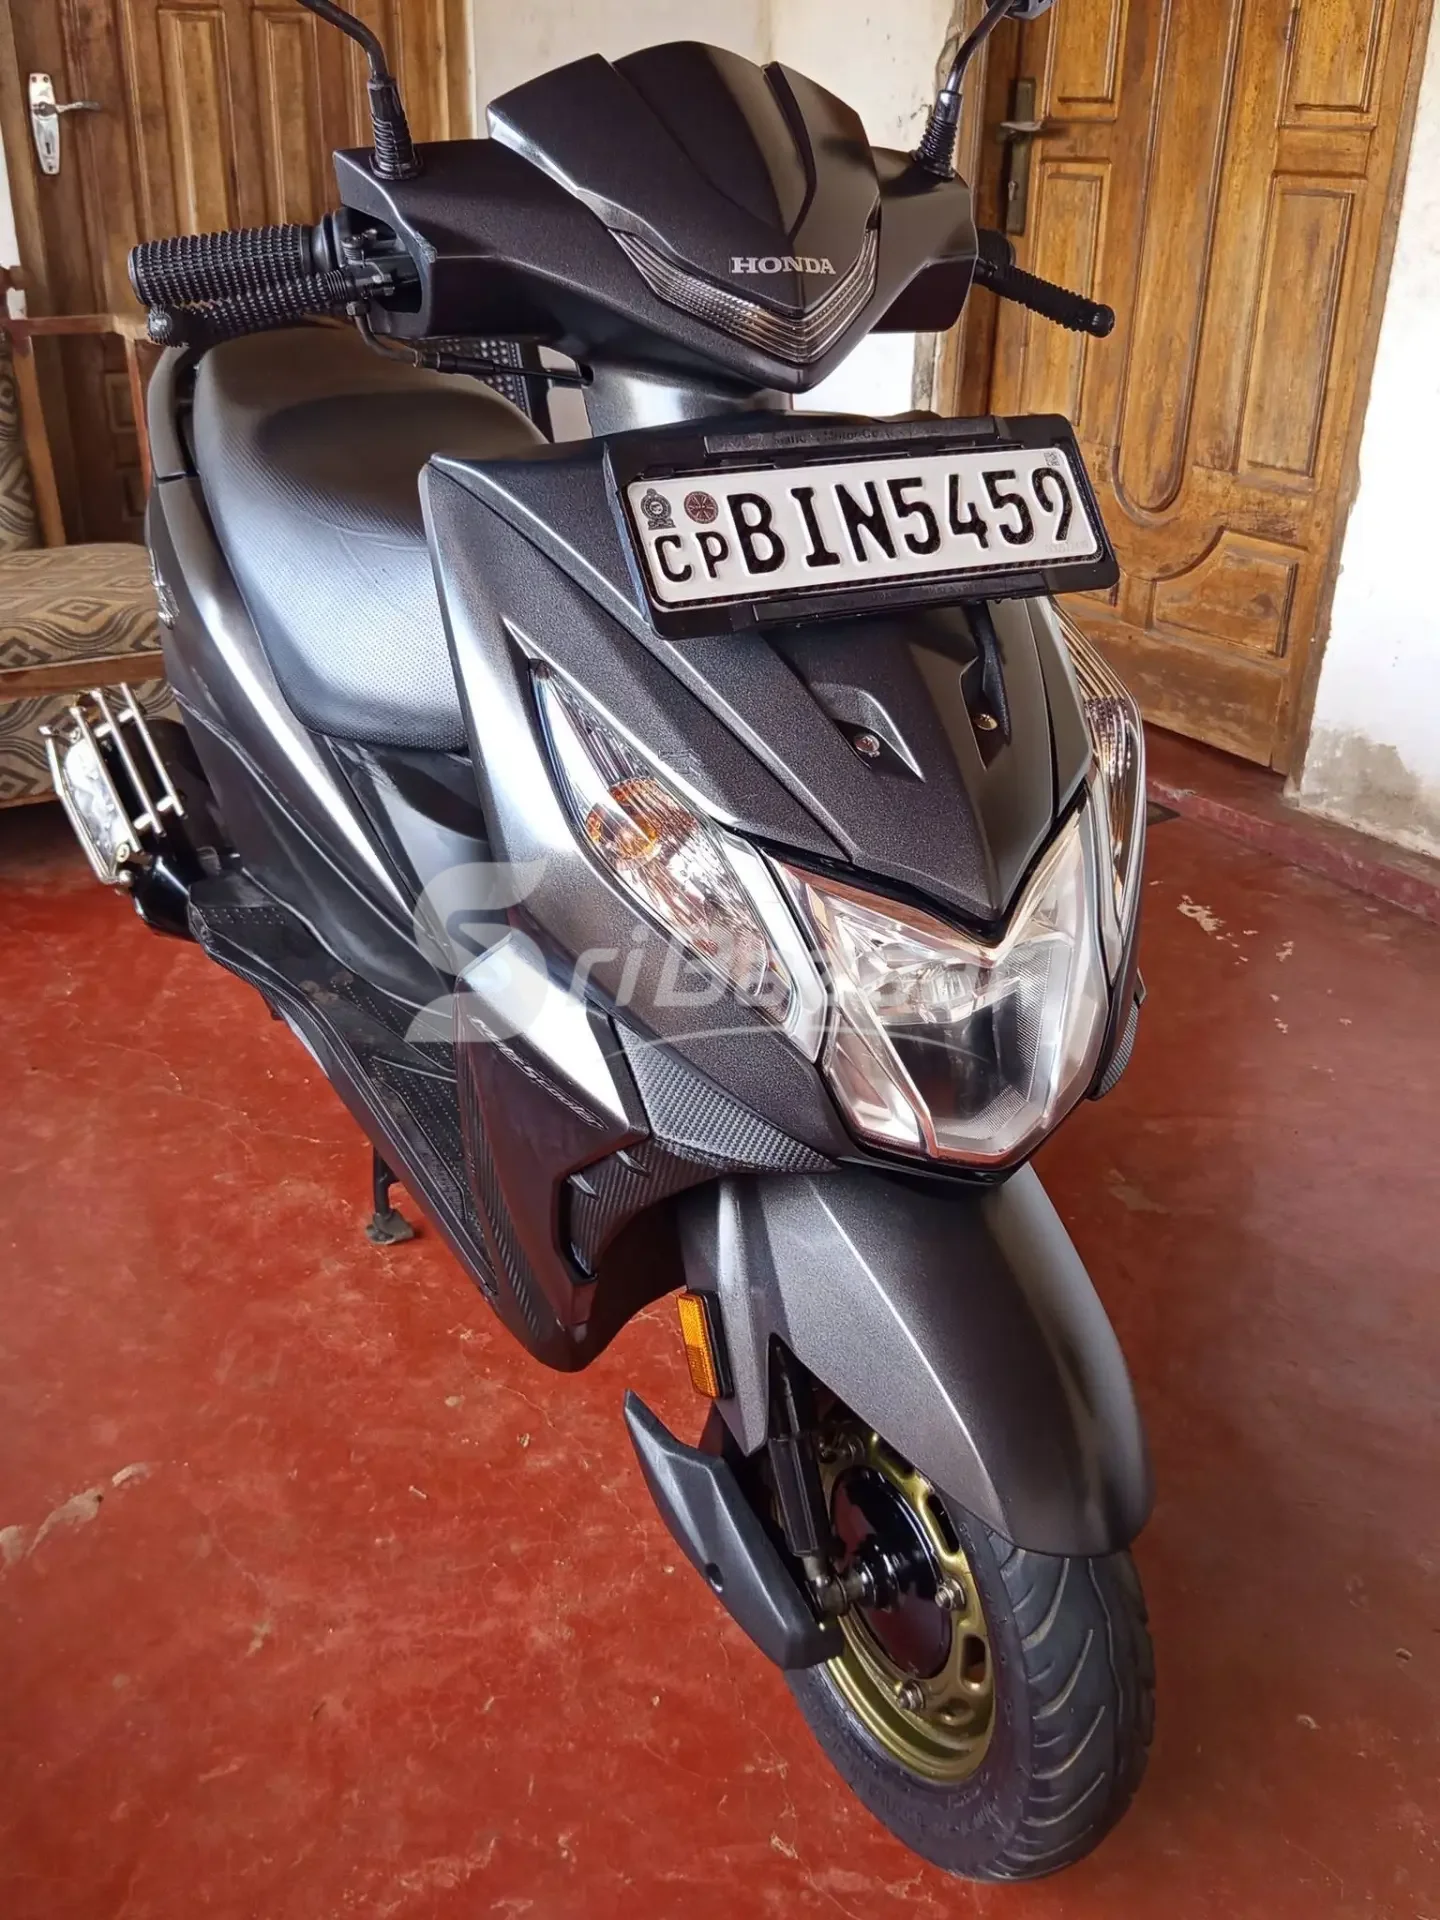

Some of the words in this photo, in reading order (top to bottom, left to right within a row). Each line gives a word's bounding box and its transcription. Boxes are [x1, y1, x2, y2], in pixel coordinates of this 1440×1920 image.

[730, 256, 836, 275] HONDA
[654, 531, 729, 583] CP
[726, 467, 1073, 575] BIN5459
